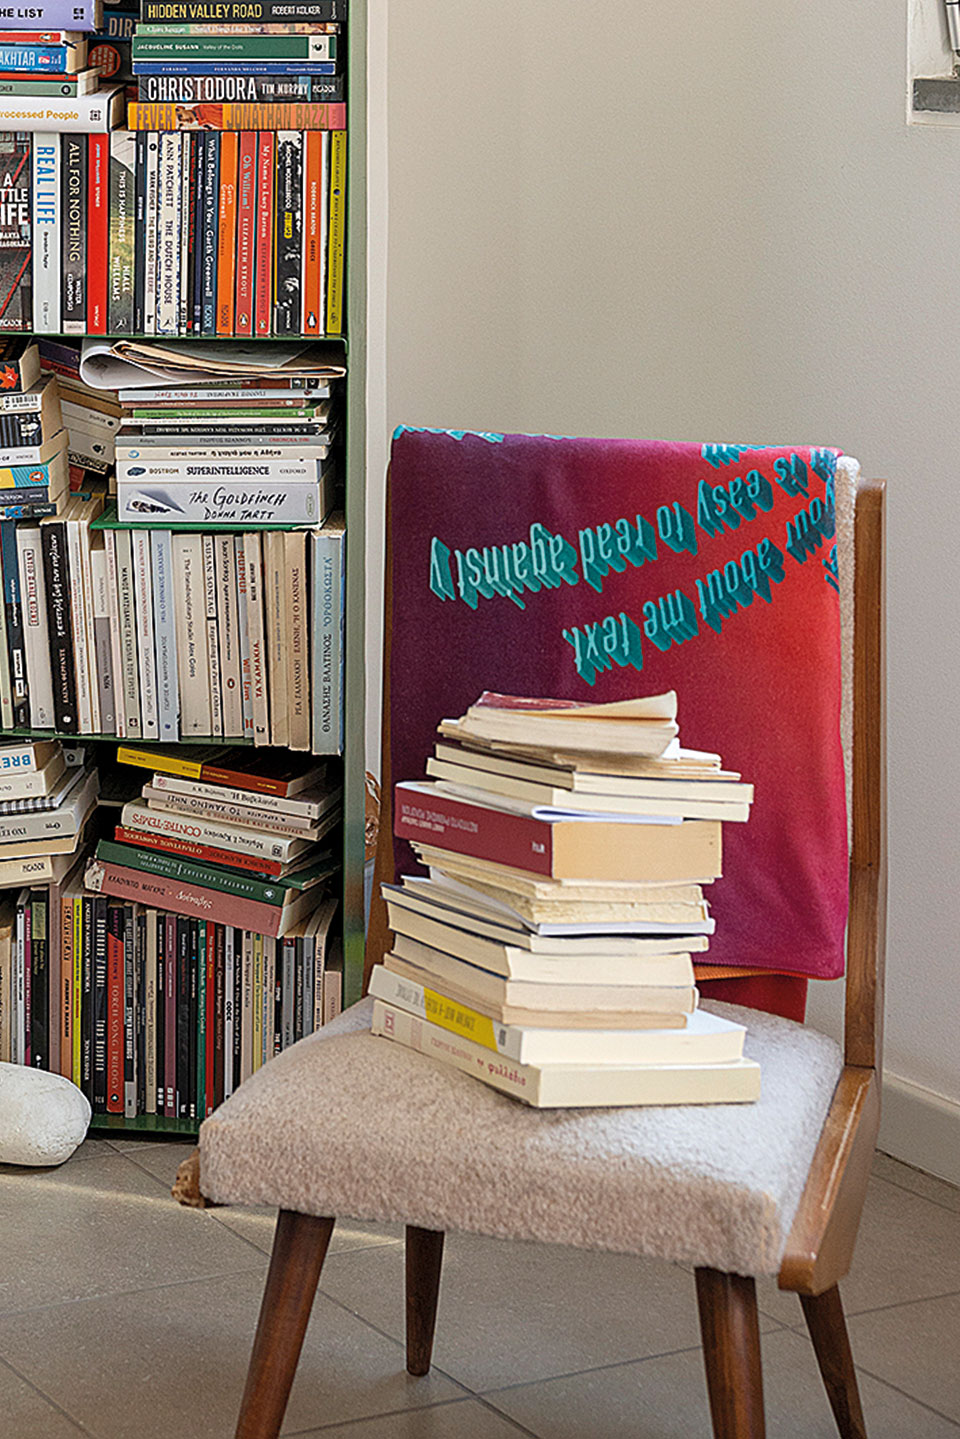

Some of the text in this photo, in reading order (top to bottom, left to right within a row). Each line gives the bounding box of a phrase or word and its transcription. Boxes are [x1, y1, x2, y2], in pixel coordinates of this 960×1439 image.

[17, 8, 44, 18] LIST
[148, 4, 320, 18] HIDDEN VALLEY ROAD ROBERT KOLKER
[148, 77, 257, 100] CHRISTODORA
[276, 84, 308, 95] MURPHY
[46, 110, 79, 121] People
[137, 104, 329, 127] FEVER JONATHAN BAZZI
[207, 140, 215, 161] What
[3, 173, 13, 186] A
[37, 146, 55, 224] REAL LIFE
[204, 164, 214, 195] Belongs
[69, 142, 81, 262] ALL FOR NOTHING
[206, 196, 213, 205] to
[164, 140, 174, 304] ANN PATCHETT THE DUTCH HOUSE
[204, 230, 213, 254] Garth
[240, 155, 251, 297] Oh William! ELIZABETH STROUT
[112, 256, 121, 300] WILLIAMS
[204, 256, 213, 296] Greenwell
[186, 466, 270, 476] SUPERINTELLIGENCE
[189, 491, 209, 504] The
[204, 508, 274, 520] DONNA TARTT
[697, 470, 773, 537] easy
[656, 502, 697, 556] to
[238, 550, 246, 594] MURMUR
[456, 523, 578, 609] against
[579, 515, 657, 592] read
[696, 538, 784, 634] about
[643, 590, 698, 651] me
[322, 634, 331, 732] ΘΑΝΑΣΗΣ ΒΑΛΤΙΝΟΣ
[132, 813, 201, 837] CONTRE-TEMPS
[111, 984, 120, 1090] TORCH SONG TRILOGY
